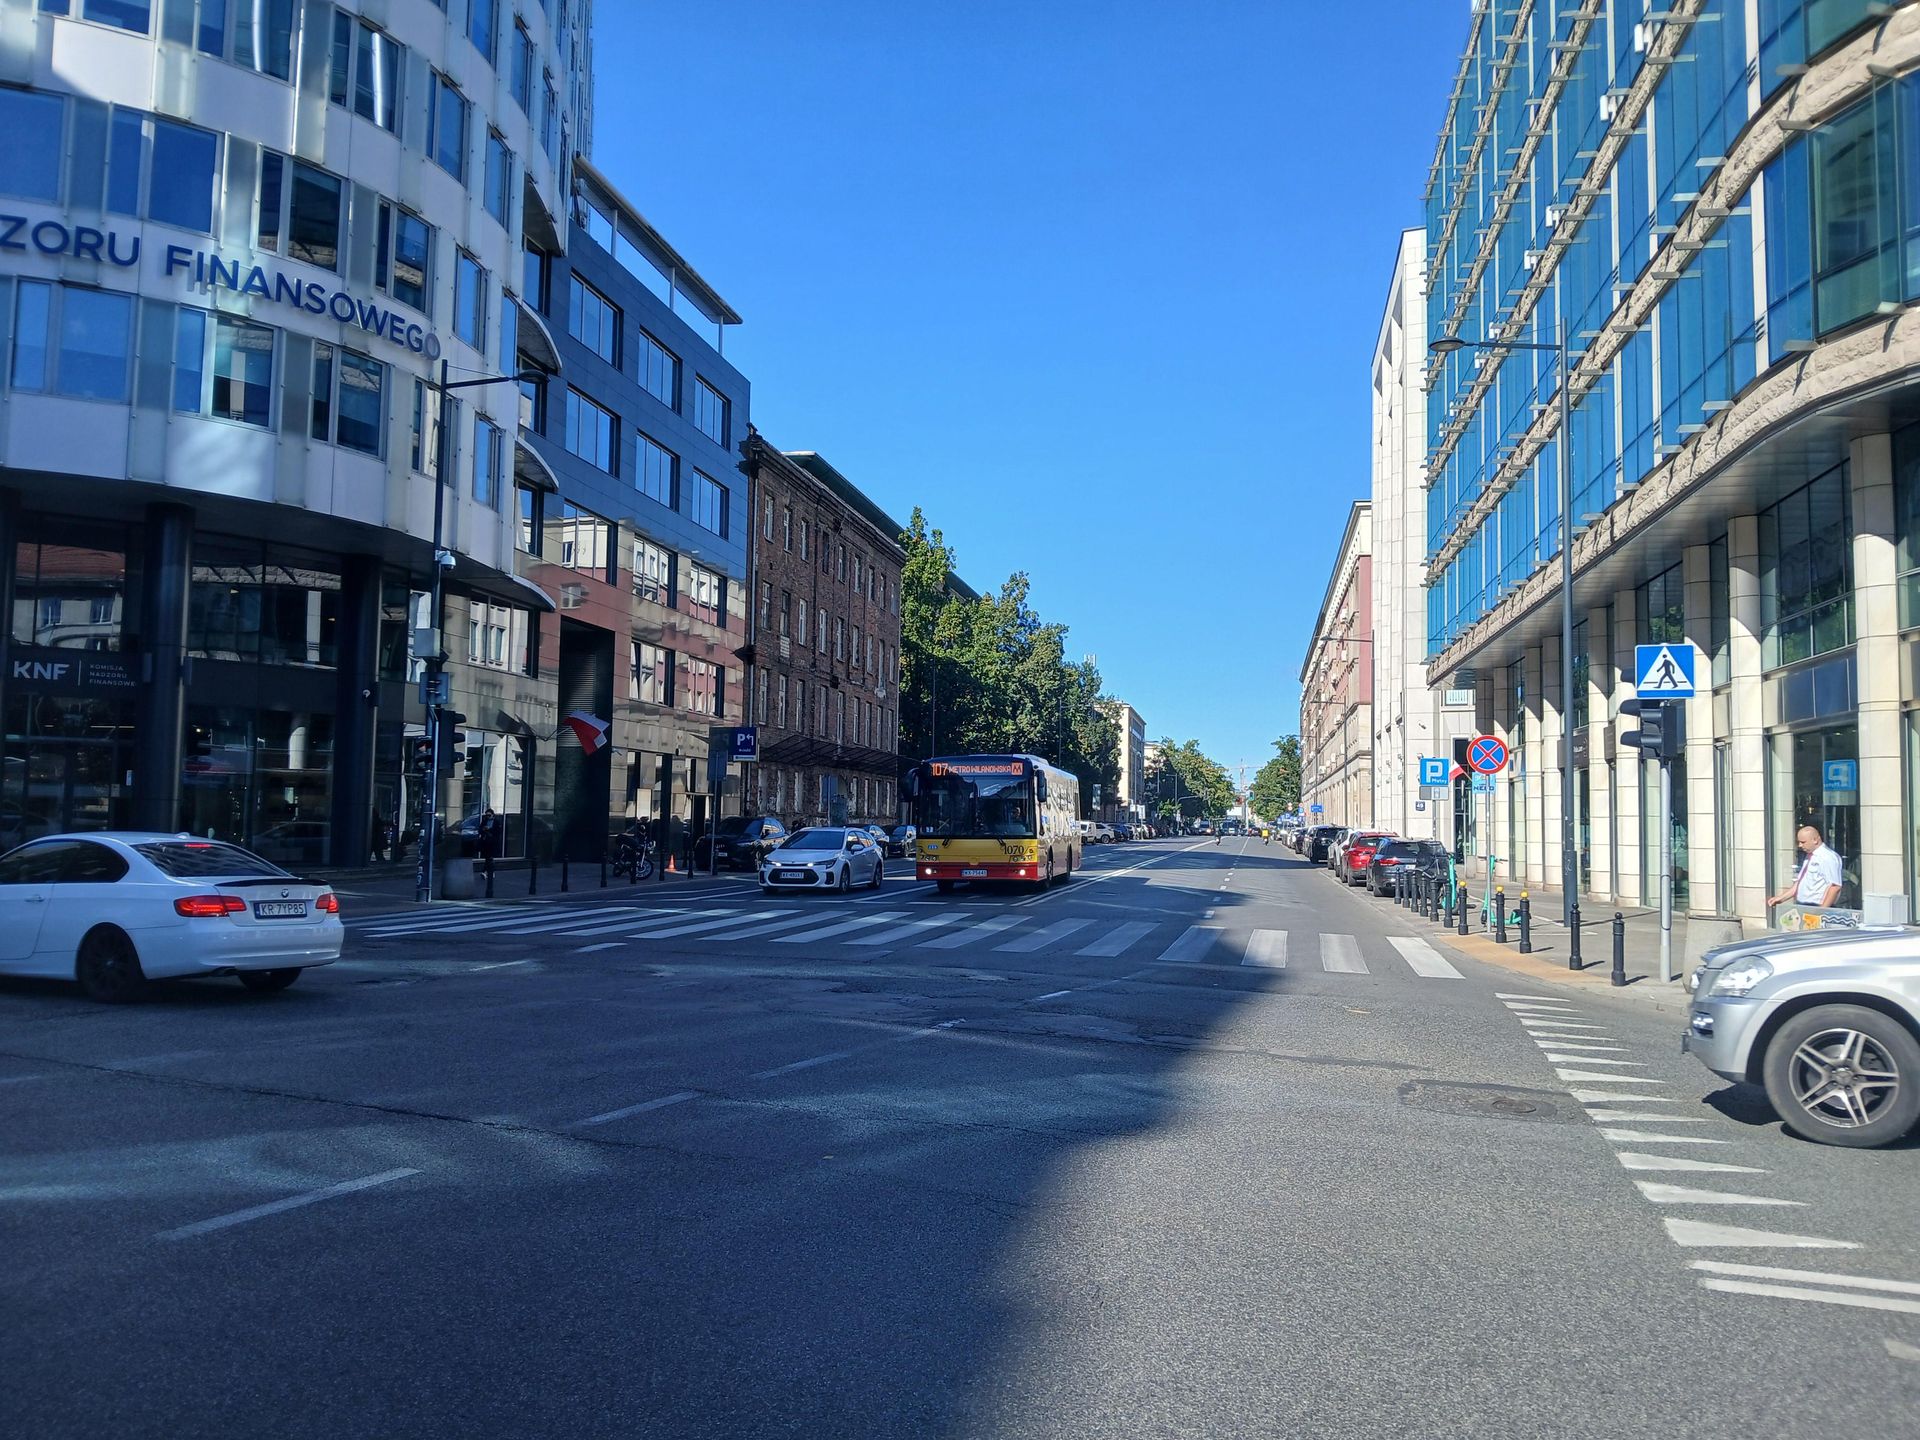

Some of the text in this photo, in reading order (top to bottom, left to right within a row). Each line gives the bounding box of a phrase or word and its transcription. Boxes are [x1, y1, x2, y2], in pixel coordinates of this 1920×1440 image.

[166, 244, 441, 361] FINANSOWEGO
[13, 661, 70, 680] KNF
[89, 671, 127, 679] NADZORU
[737, 734, 746, 746] P
[932, 763, 948, 776] 107
[949, 765, 971, 774] METRO
[971, 765, 1011, 774] WILANOWSKA
[1426, 761, 1443, 783] P
[1003, 845, 1024, 854] 1070
[261, 903, 304, 915] KR 7YP85
